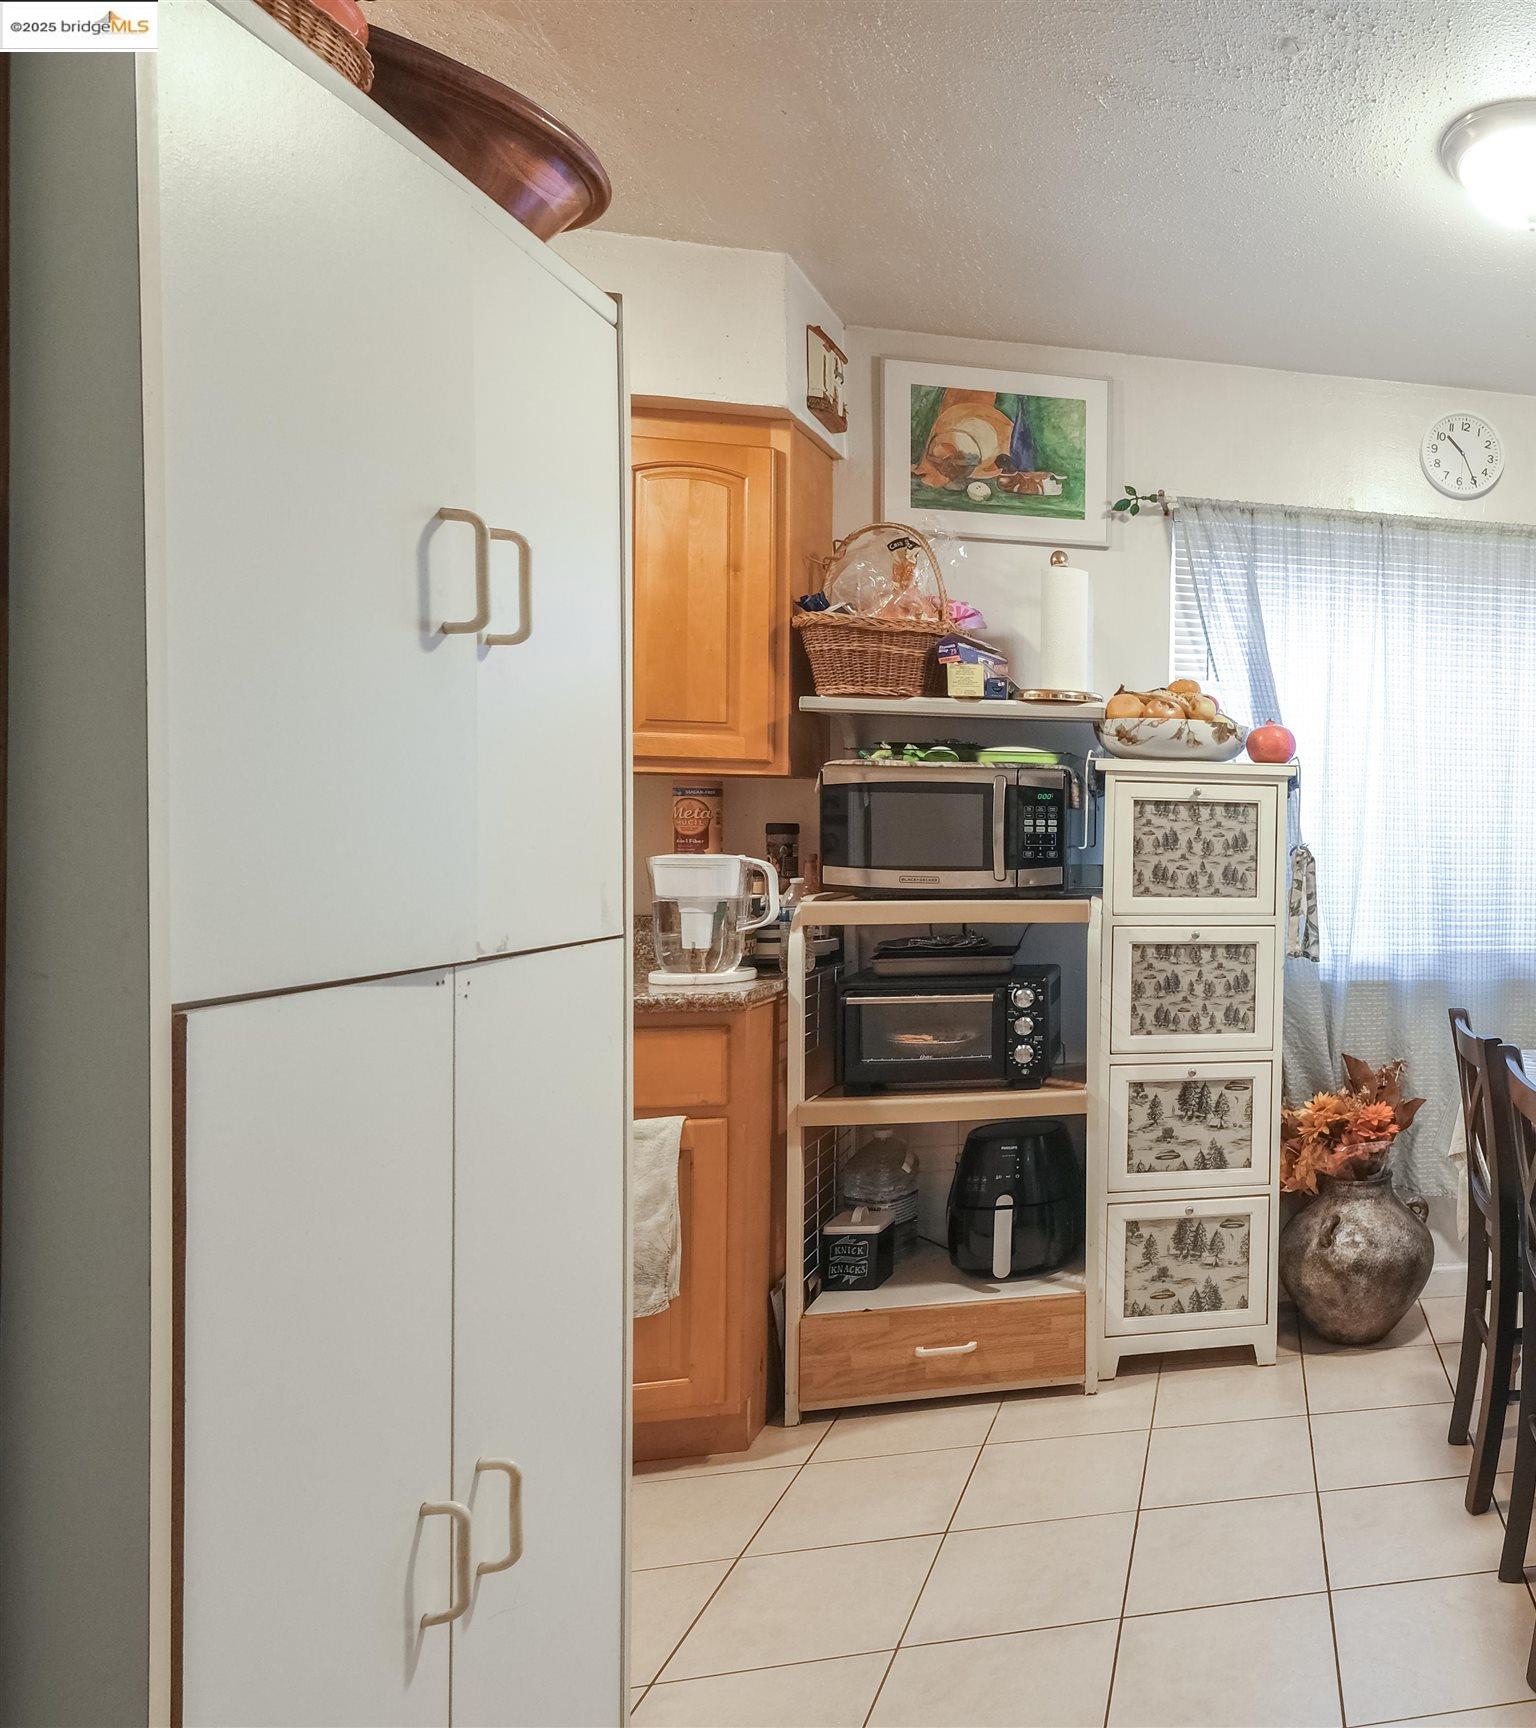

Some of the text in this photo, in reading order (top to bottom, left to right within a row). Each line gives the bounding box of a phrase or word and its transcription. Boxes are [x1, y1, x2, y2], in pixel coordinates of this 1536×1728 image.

[1449, 423, 1455, 432] 11
[1461, 422, 1471, 432] 12
[1436, 431, 1446, 441] 10
[1477, 428, 1481, 437] 1
[1431, 443, 1438, 453] 9
[1484, 440, 1492, 449] 2
[1433, 458, 1441, 468] 8
[1487, 454, 1494, 463] 3
[1443, 470, 1450, 480] 7
[1481, 468, 1488, 477] 4
[1456, 476, 1463, 486] 6
[1470, 476, 1477, 485] 5
[834, 1245, 864, 1255] KNICK
[831, 1266, 866, 1274] KNACKS
